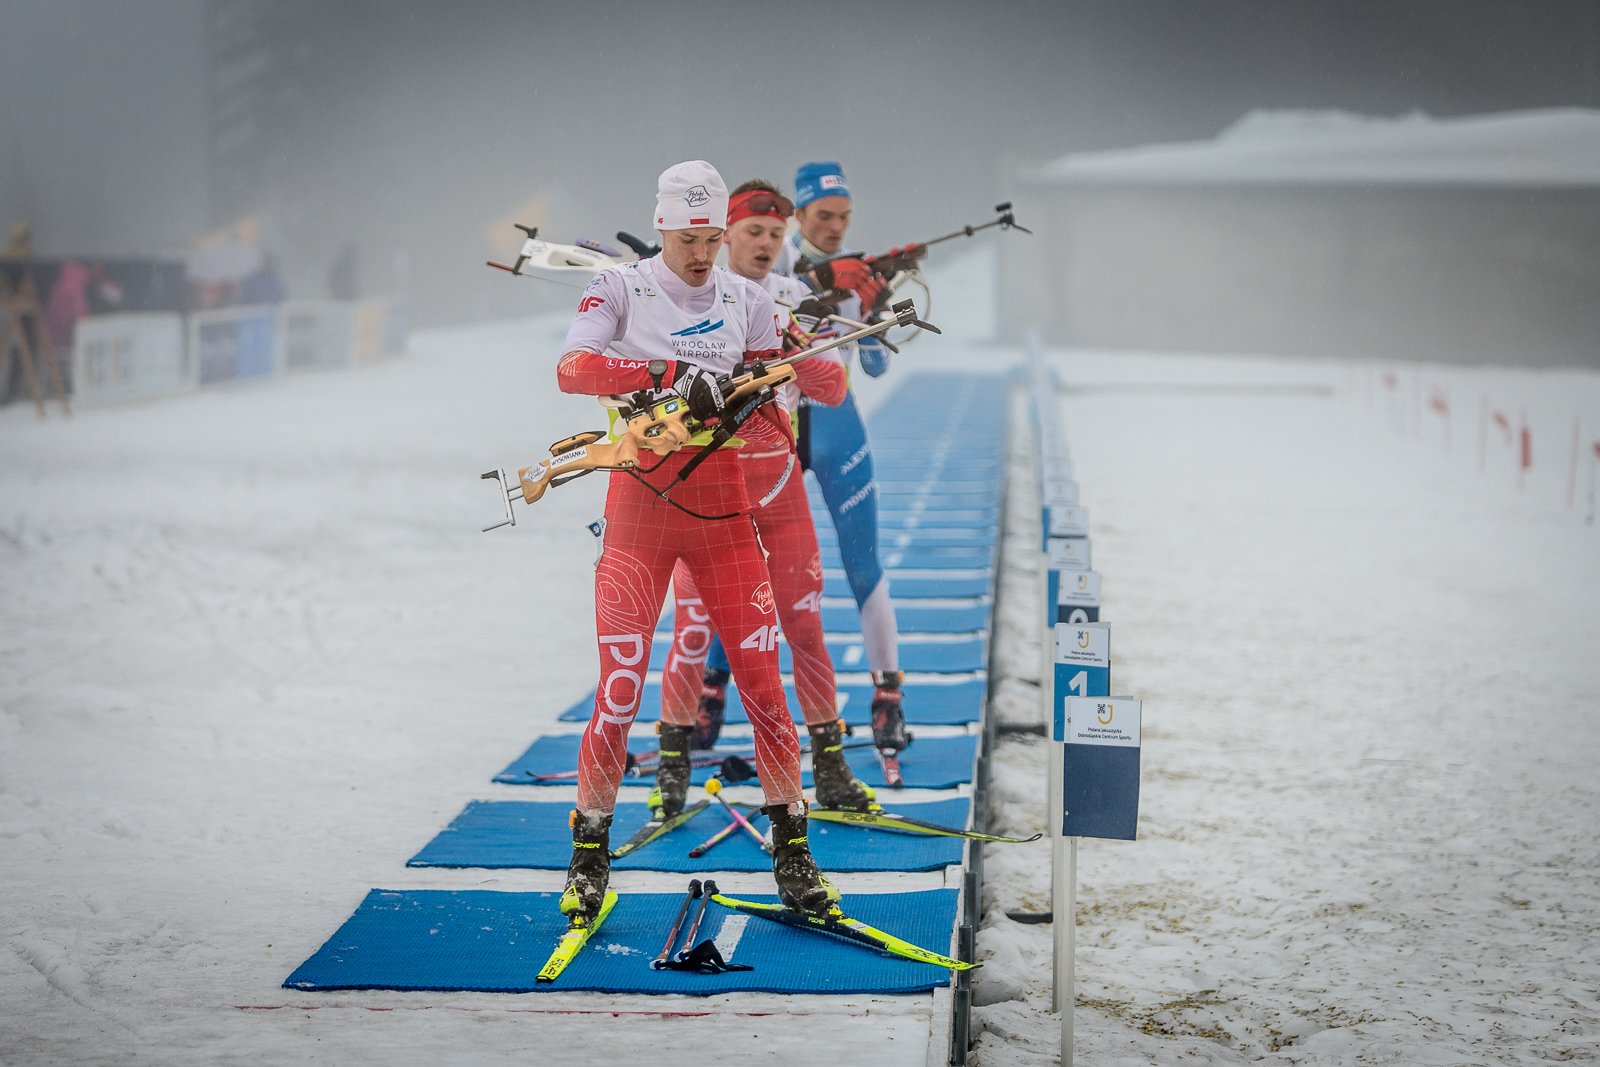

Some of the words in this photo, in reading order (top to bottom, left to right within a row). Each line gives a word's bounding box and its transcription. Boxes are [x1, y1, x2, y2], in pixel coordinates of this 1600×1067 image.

[675, 349, 724, 359] AIRPORT
[593, 633, 644, 735] POL
[1069, 671, 1088, 697] 1
[843, 812, 878, 823] FISCHER
[572, 841, 601, 849] CHER
